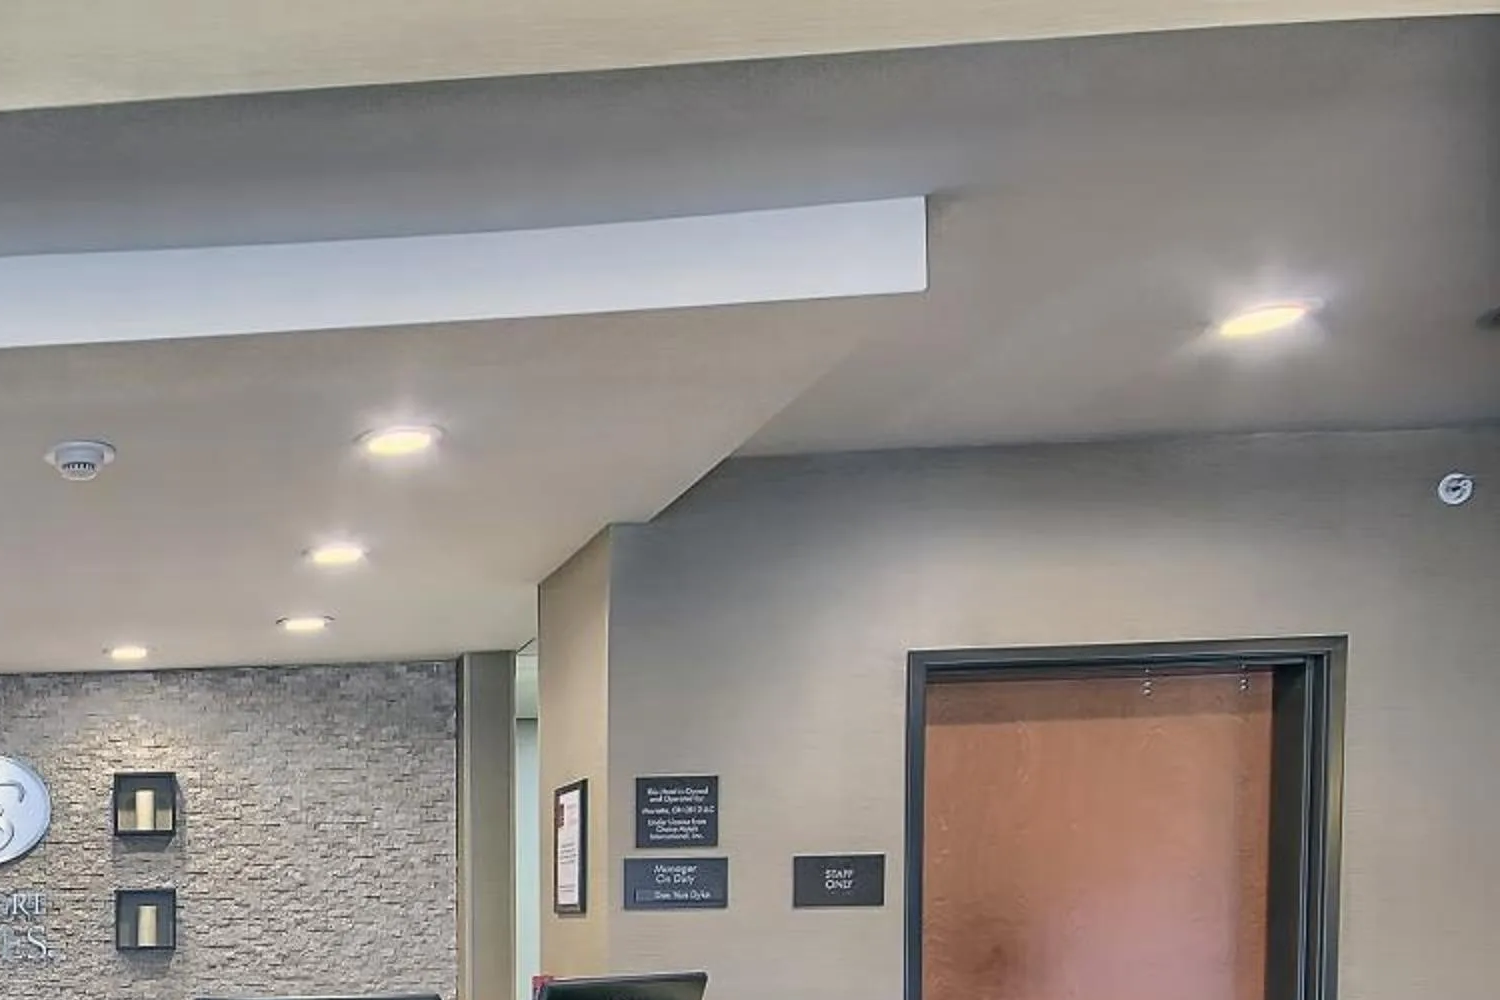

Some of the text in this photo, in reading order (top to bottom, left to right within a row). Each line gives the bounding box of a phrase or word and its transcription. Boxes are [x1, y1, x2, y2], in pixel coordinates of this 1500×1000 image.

[653, 864, 698, 875] Manager
[825, 868, 853, 879] STAFF
[655, 873, 696, 885] On Duty
[825, 879, 853, 890] ONLY
